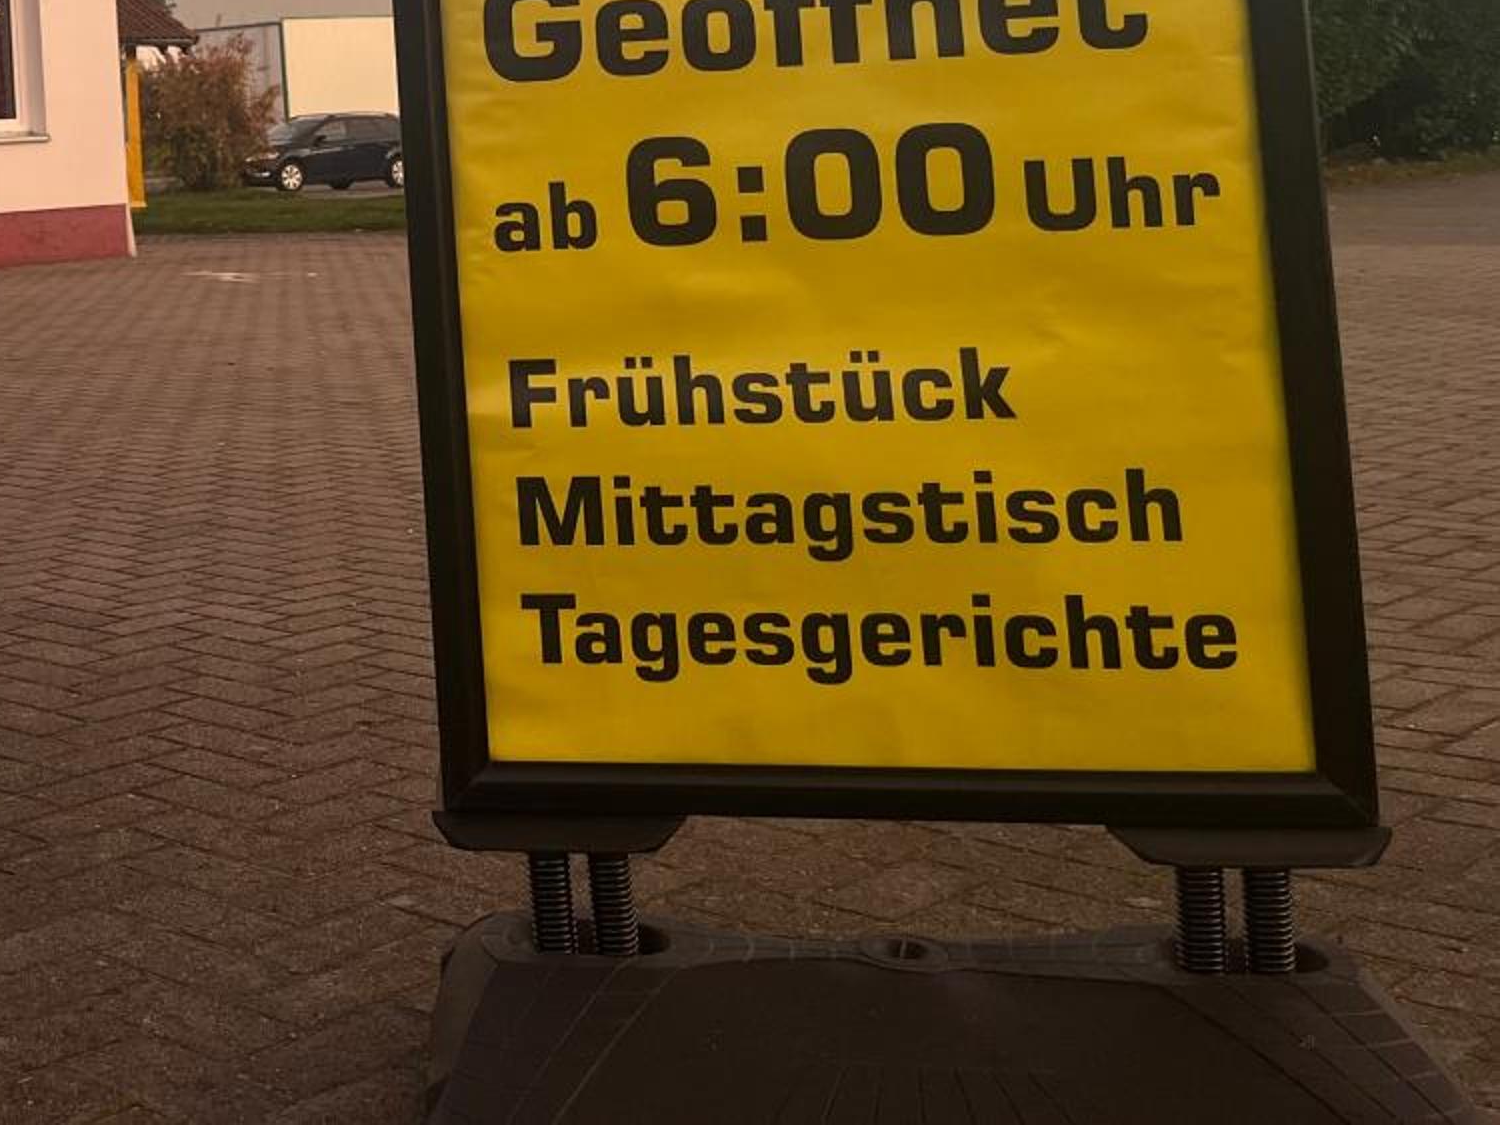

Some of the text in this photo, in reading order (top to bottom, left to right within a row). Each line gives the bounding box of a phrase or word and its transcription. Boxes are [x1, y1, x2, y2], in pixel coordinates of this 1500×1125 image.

[493, 122, 1221, 253] ab 6:00 Uhr
[507, 346, 1018, 429] Frühstück
[515, 468, 1183, 563] Mittagstisch
[520, 593, 1238, 686] Tagesgerichte
